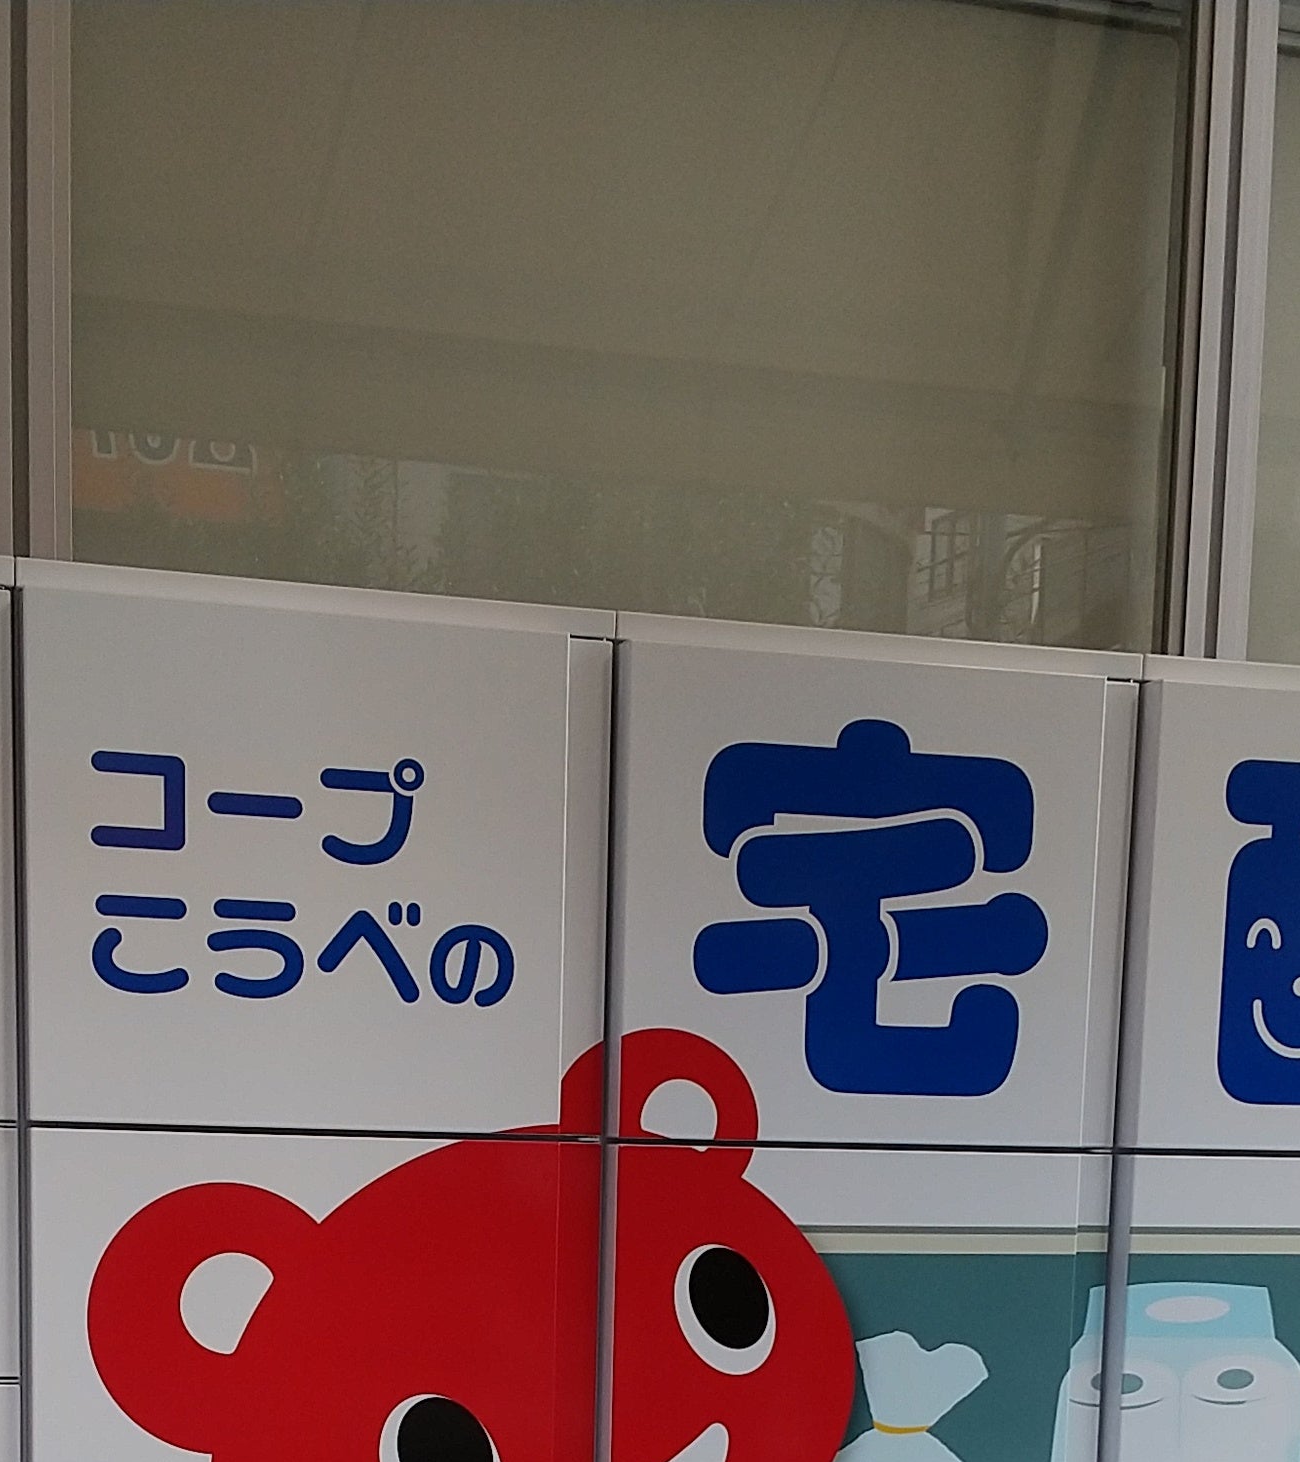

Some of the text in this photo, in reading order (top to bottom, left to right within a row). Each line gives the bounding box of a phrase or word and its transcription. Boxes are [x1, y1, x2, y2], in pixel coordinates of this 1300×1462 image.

[91, 749, 424, 866] コープ
[91, 899, 514, 1008] こうべの
